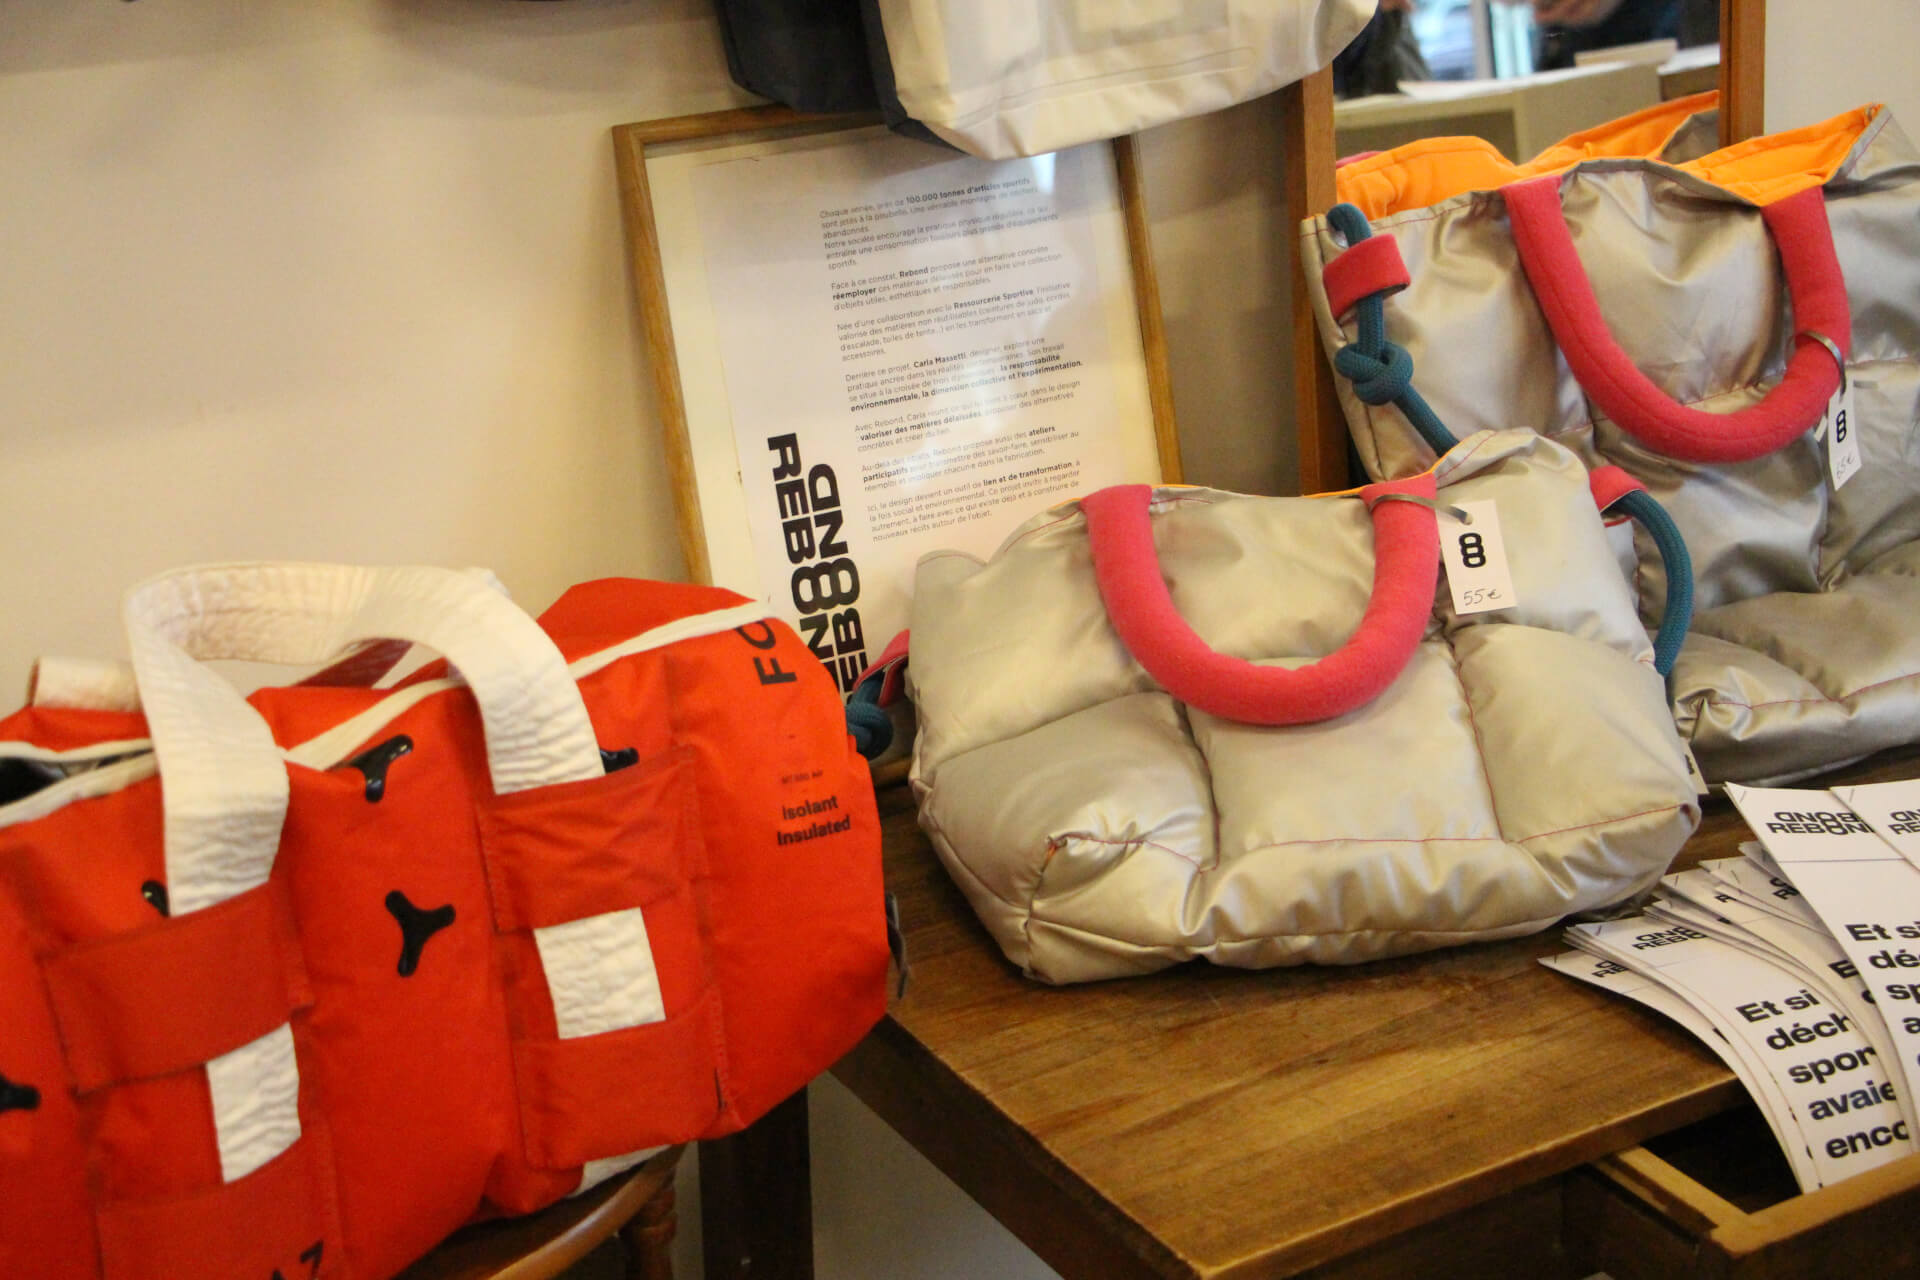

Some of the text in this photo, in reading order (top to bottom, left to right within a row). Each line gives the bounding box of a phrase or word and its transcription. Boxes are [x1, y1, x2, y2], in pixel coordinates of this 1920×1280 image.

[905, 192, 938, 204] 100.000
[938, 189, 965, 198] tonnes
[965, 183, 1001, 194] d'articles
[897, 265, 929, 277] Rebond
[952, 294, 1002, 309] Ressourcerie
[911, 358, 934, 368] Carla
[929, 383, 970, 395] dimension
[859, 429, 893, 440] valoriser
[892, 426, 908, 434] des
[1027, 426, 1056, 436] ateliers
[862, 466, 909, 483] participatifs
[981, 478, 997, 486] lien
[781, 794, 839, 821] Isolant
[776, 814, 852, 847] Insulated
[1845, 923, 1892, 942] Et
[1736, 989, 1821, 1023] Et si
